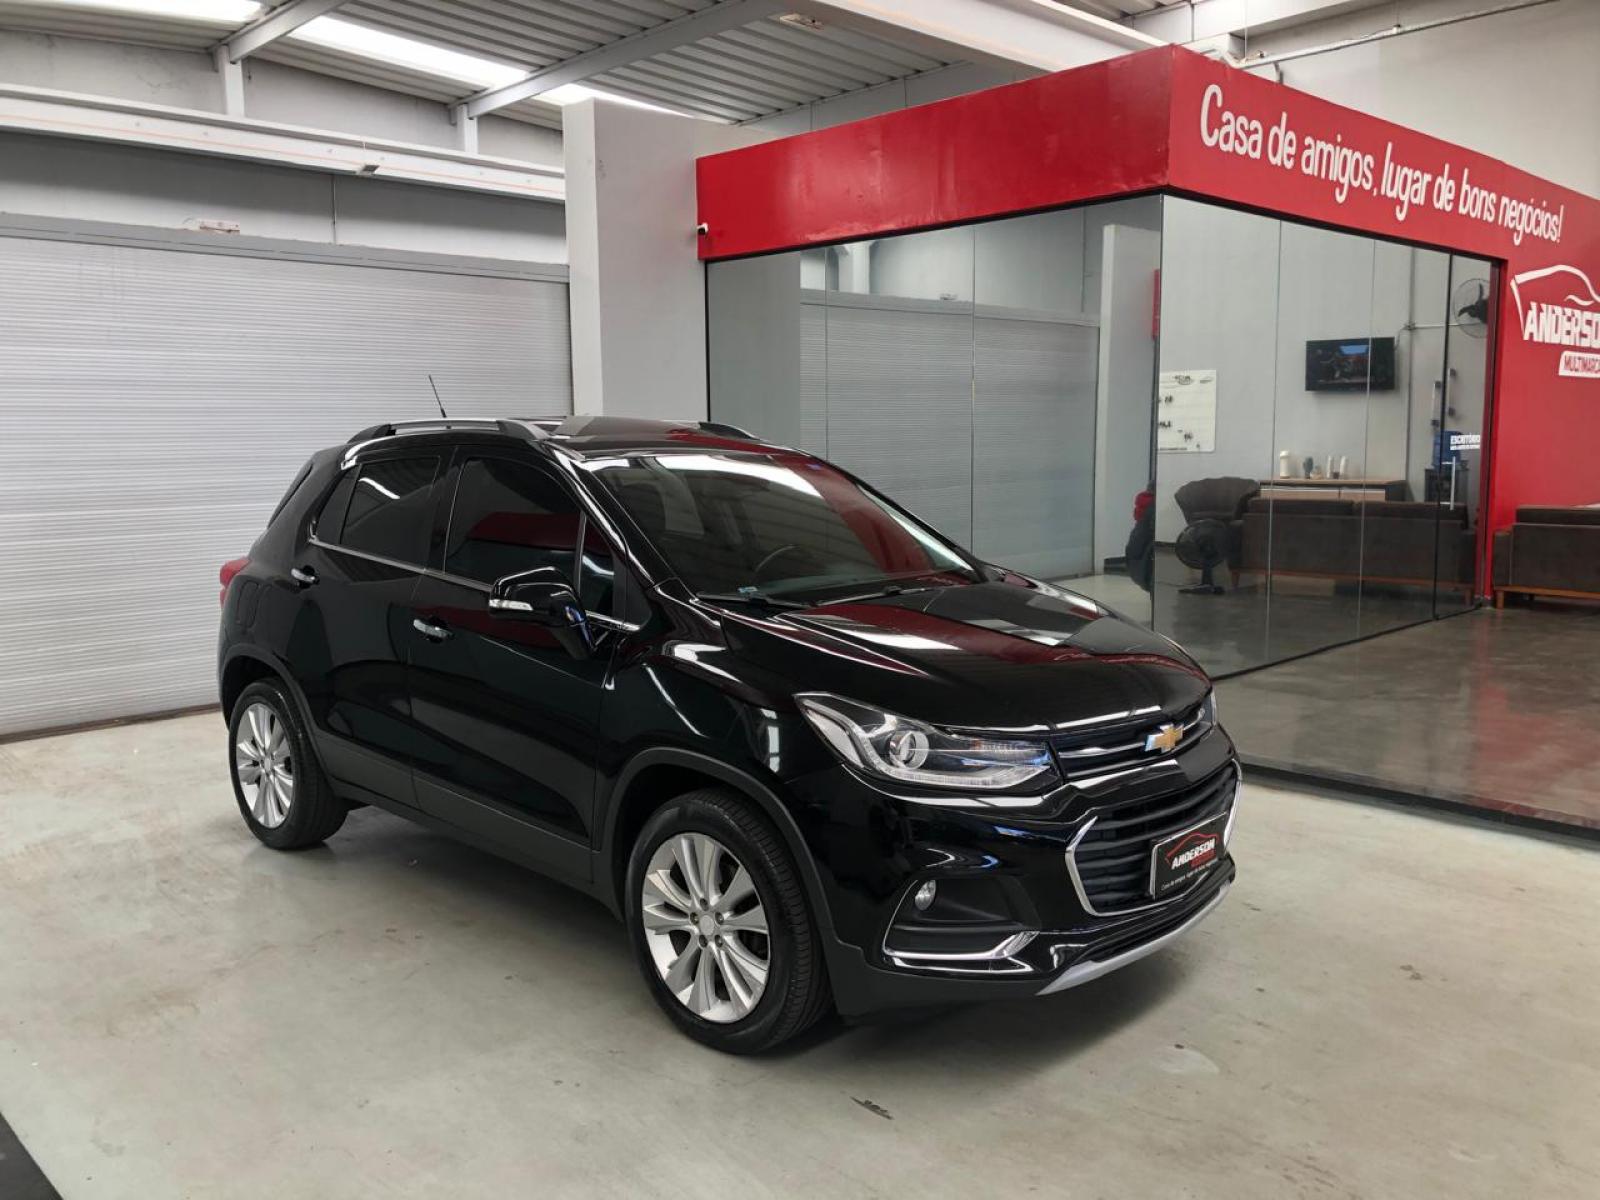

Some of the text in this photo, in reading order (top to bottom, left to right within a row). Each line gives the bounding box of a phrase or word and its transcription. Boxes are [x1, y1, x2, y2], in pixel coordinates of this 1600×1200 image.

[1200, 84, 1564, 246] Casa de amigos, lugar de bons negócios!
[1171, 838, 1216, 870] ANDERSON
